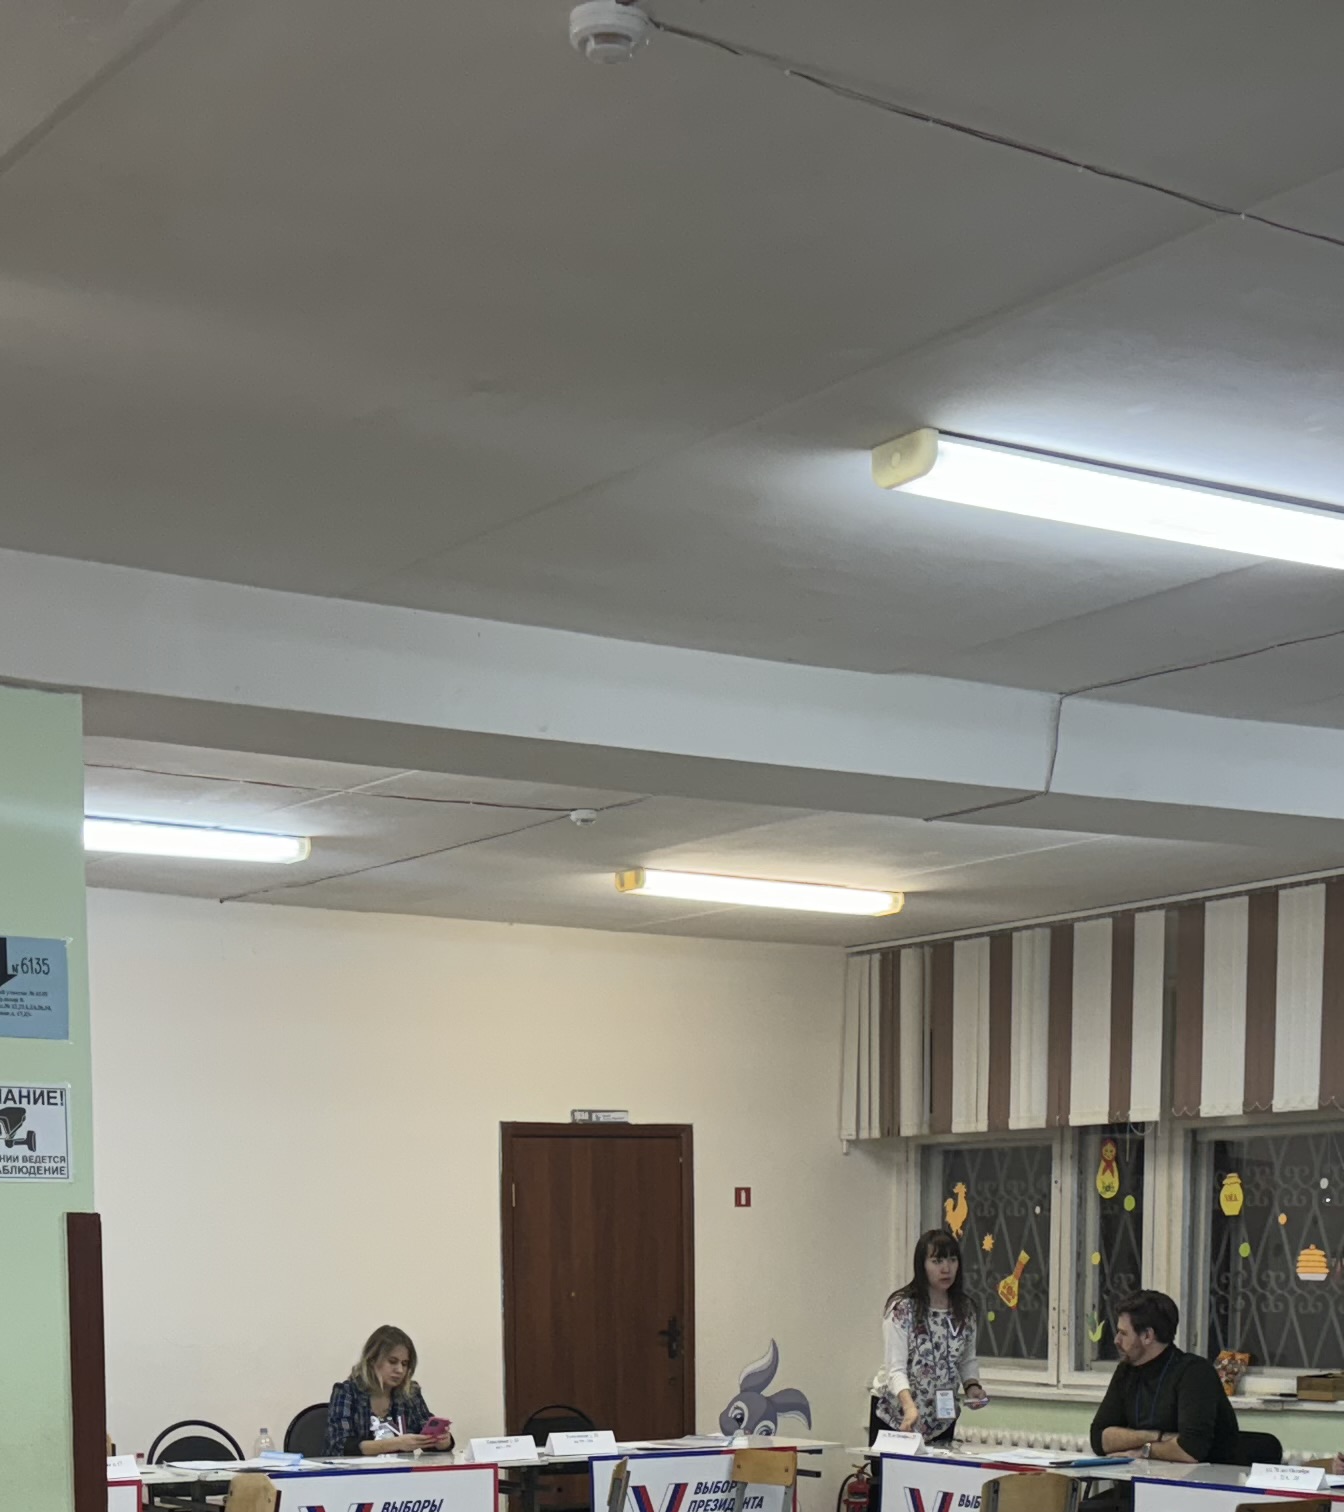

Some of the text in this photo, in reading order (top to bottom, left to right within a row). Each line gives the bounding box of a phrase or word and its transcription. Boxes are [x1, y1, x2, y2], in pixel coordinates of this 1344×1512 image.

[21, 957, 50, 975] 6135
[22, 1155, 66, 1164] ВЕДЕТСЯ
[694, 1480, 738, 1495] ВЫБОР
[687, 1496, 764, 1512] ПРЕЗИДНТА
[958, 1494, 982, 1508] ВЫБ
